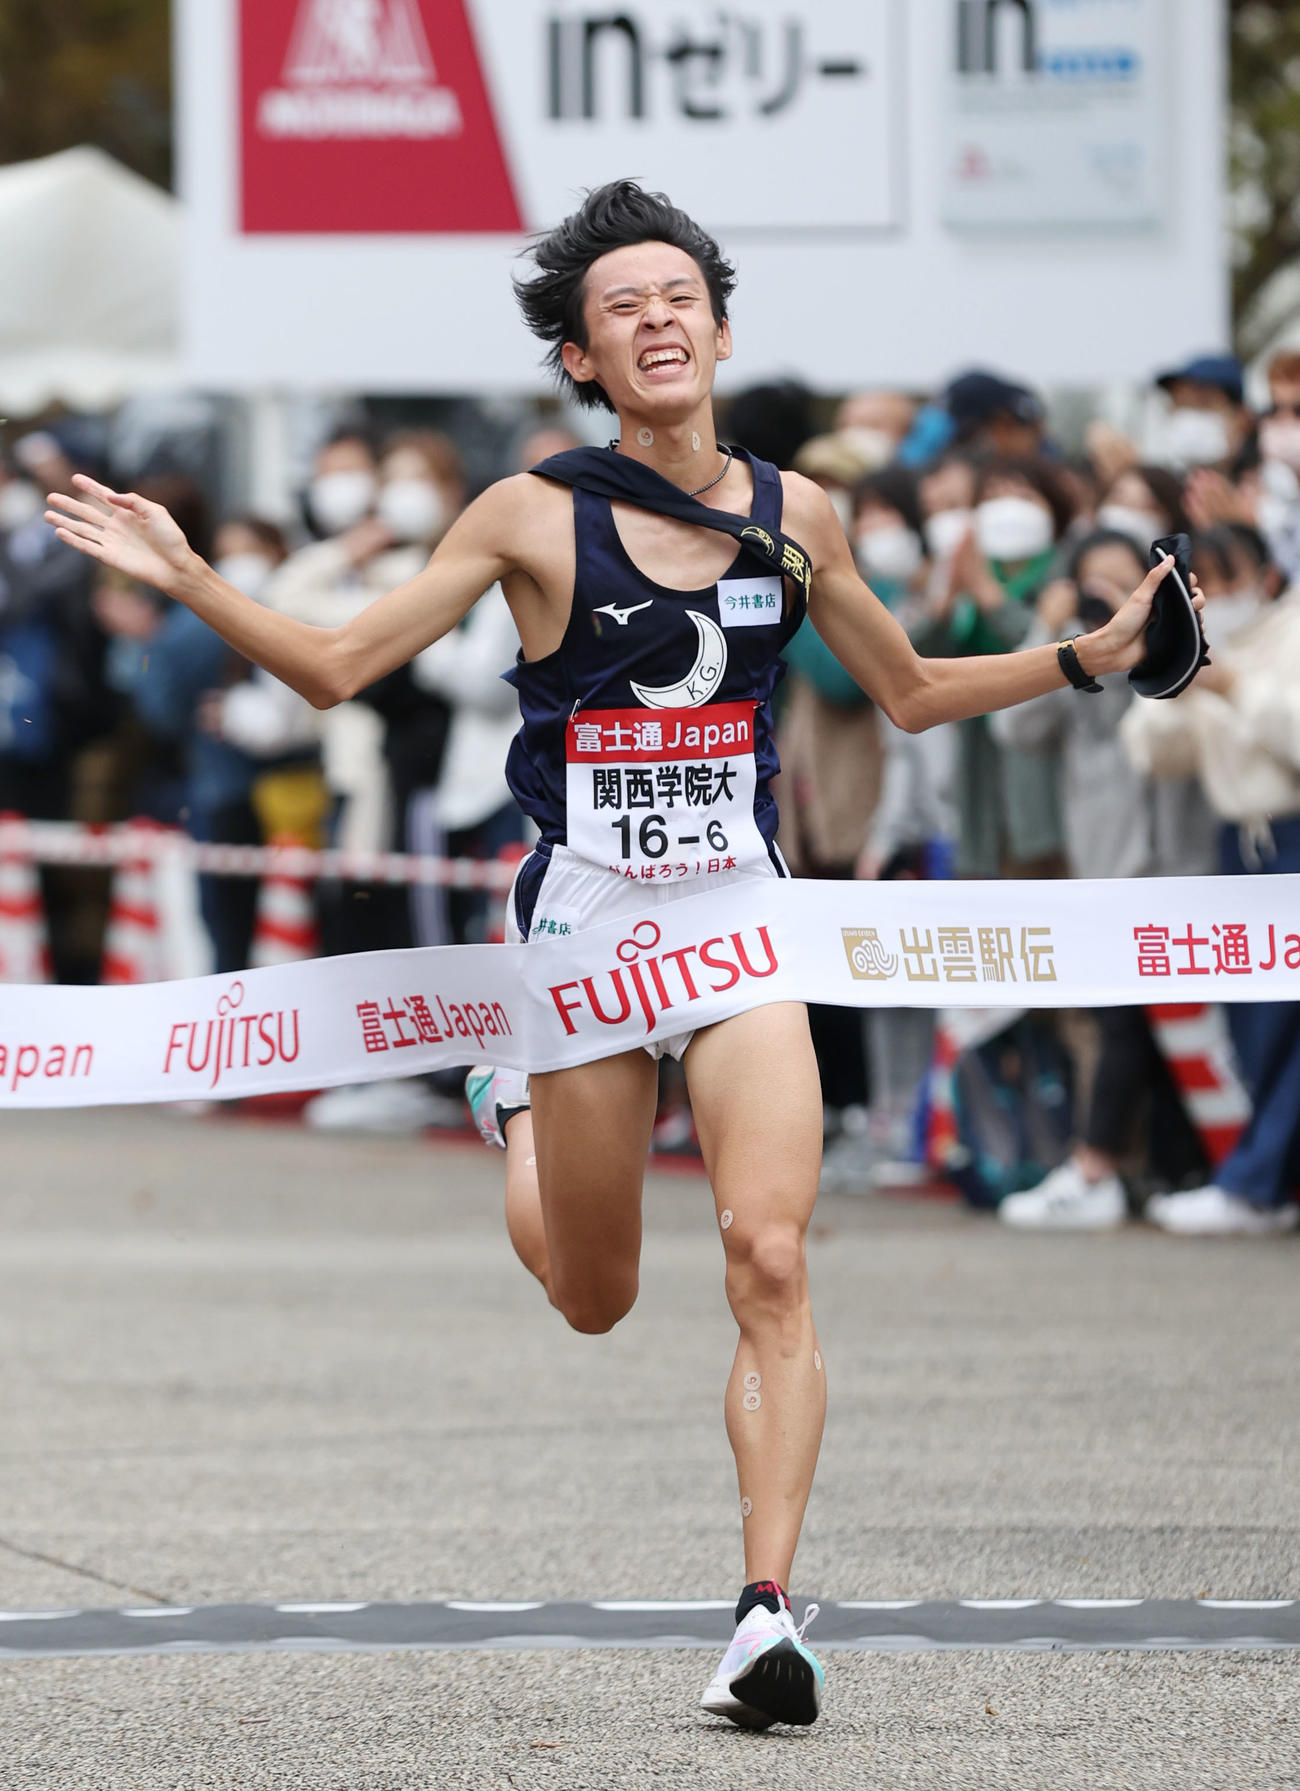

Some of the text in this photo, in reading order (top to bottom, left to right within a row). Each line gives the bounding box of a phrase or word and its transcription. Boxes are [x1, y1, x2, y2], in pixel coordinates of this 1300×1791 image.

[724, 593, 776, 611] 今井書店
[686, 661, 720, 701] K.G.
[573, 719, 749, 754] 富士通Japan
[593, 761, 737, 810] 関西学院大
[547, 920, 779, 1036] FUJITSU
[898, 926, 1058, 982] 出雲駅伝
[162, 981, 299, 1089] FUJITSU
[356, 994, 513, 1053] 富士通Japan
